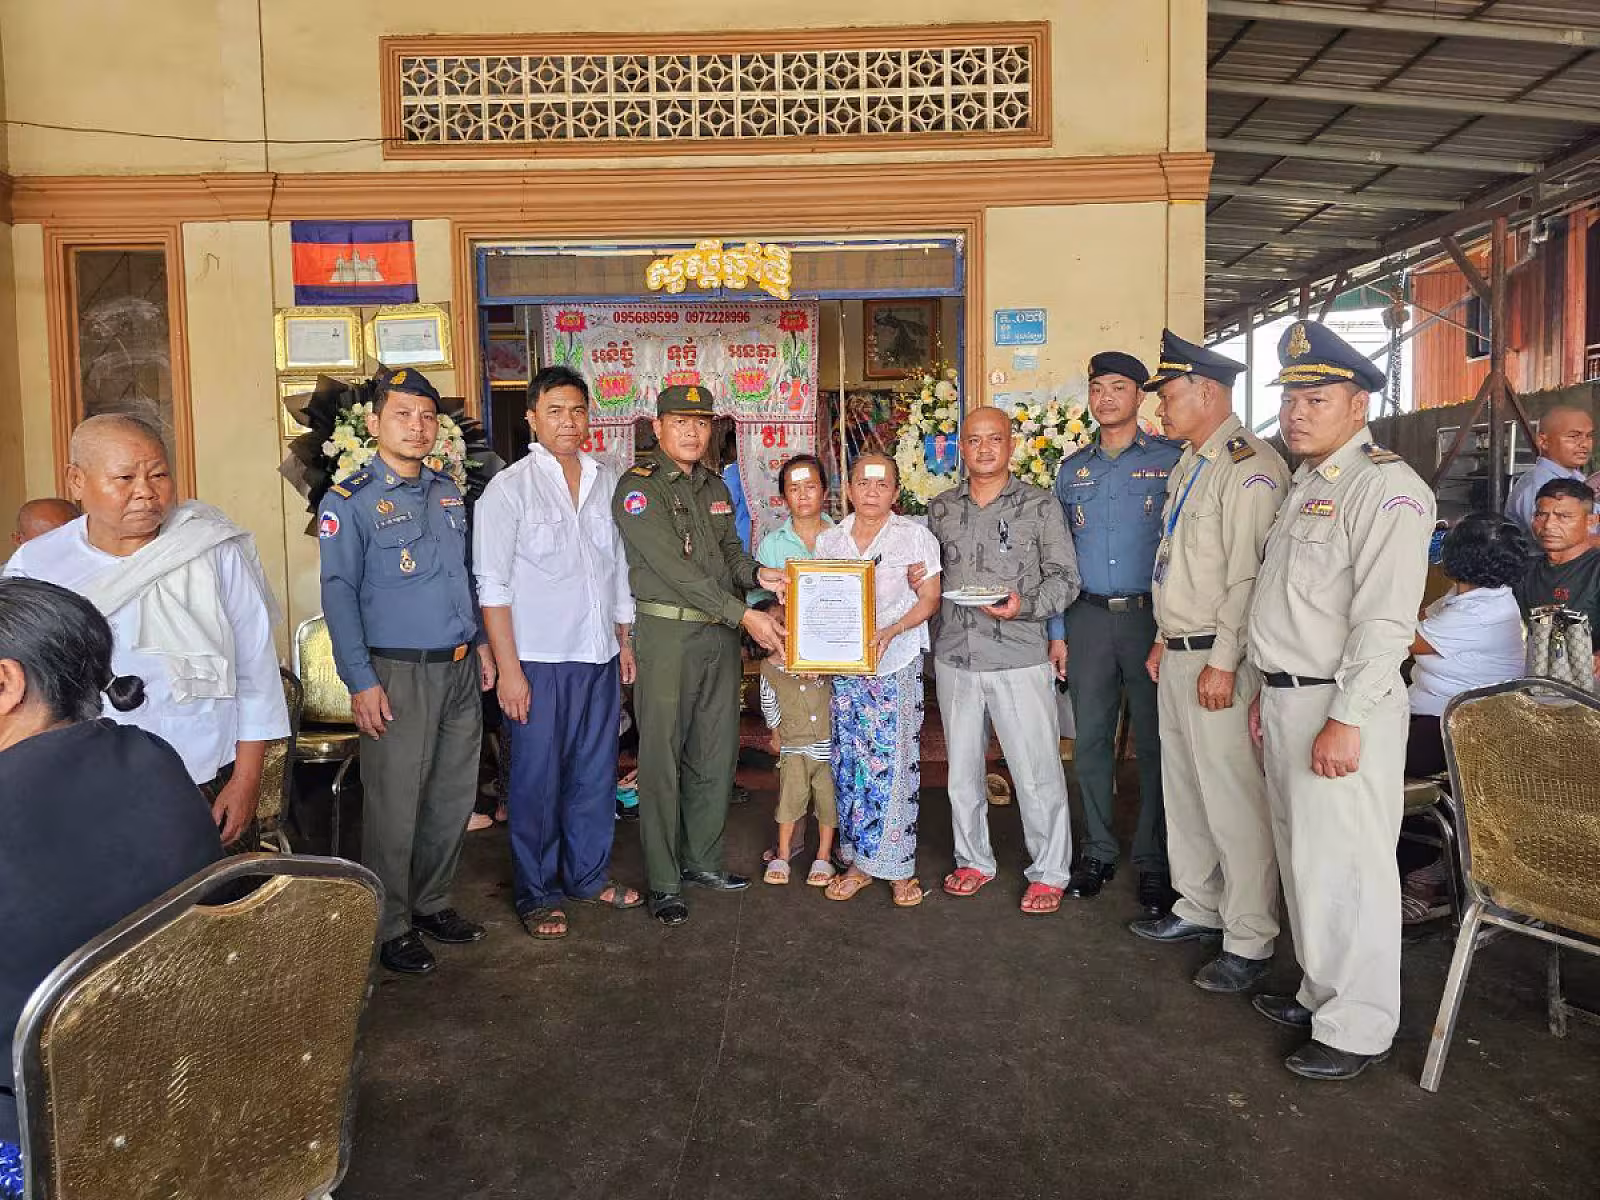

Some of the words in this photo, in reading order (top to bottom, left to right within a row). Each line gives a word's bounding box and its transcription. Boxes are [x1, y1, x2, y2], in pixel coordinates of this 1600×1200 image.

[613, 311, 680, 324] 095689599
[684, 311, 750, 324] 0972228996
[762, 425, 788, 448] 81
